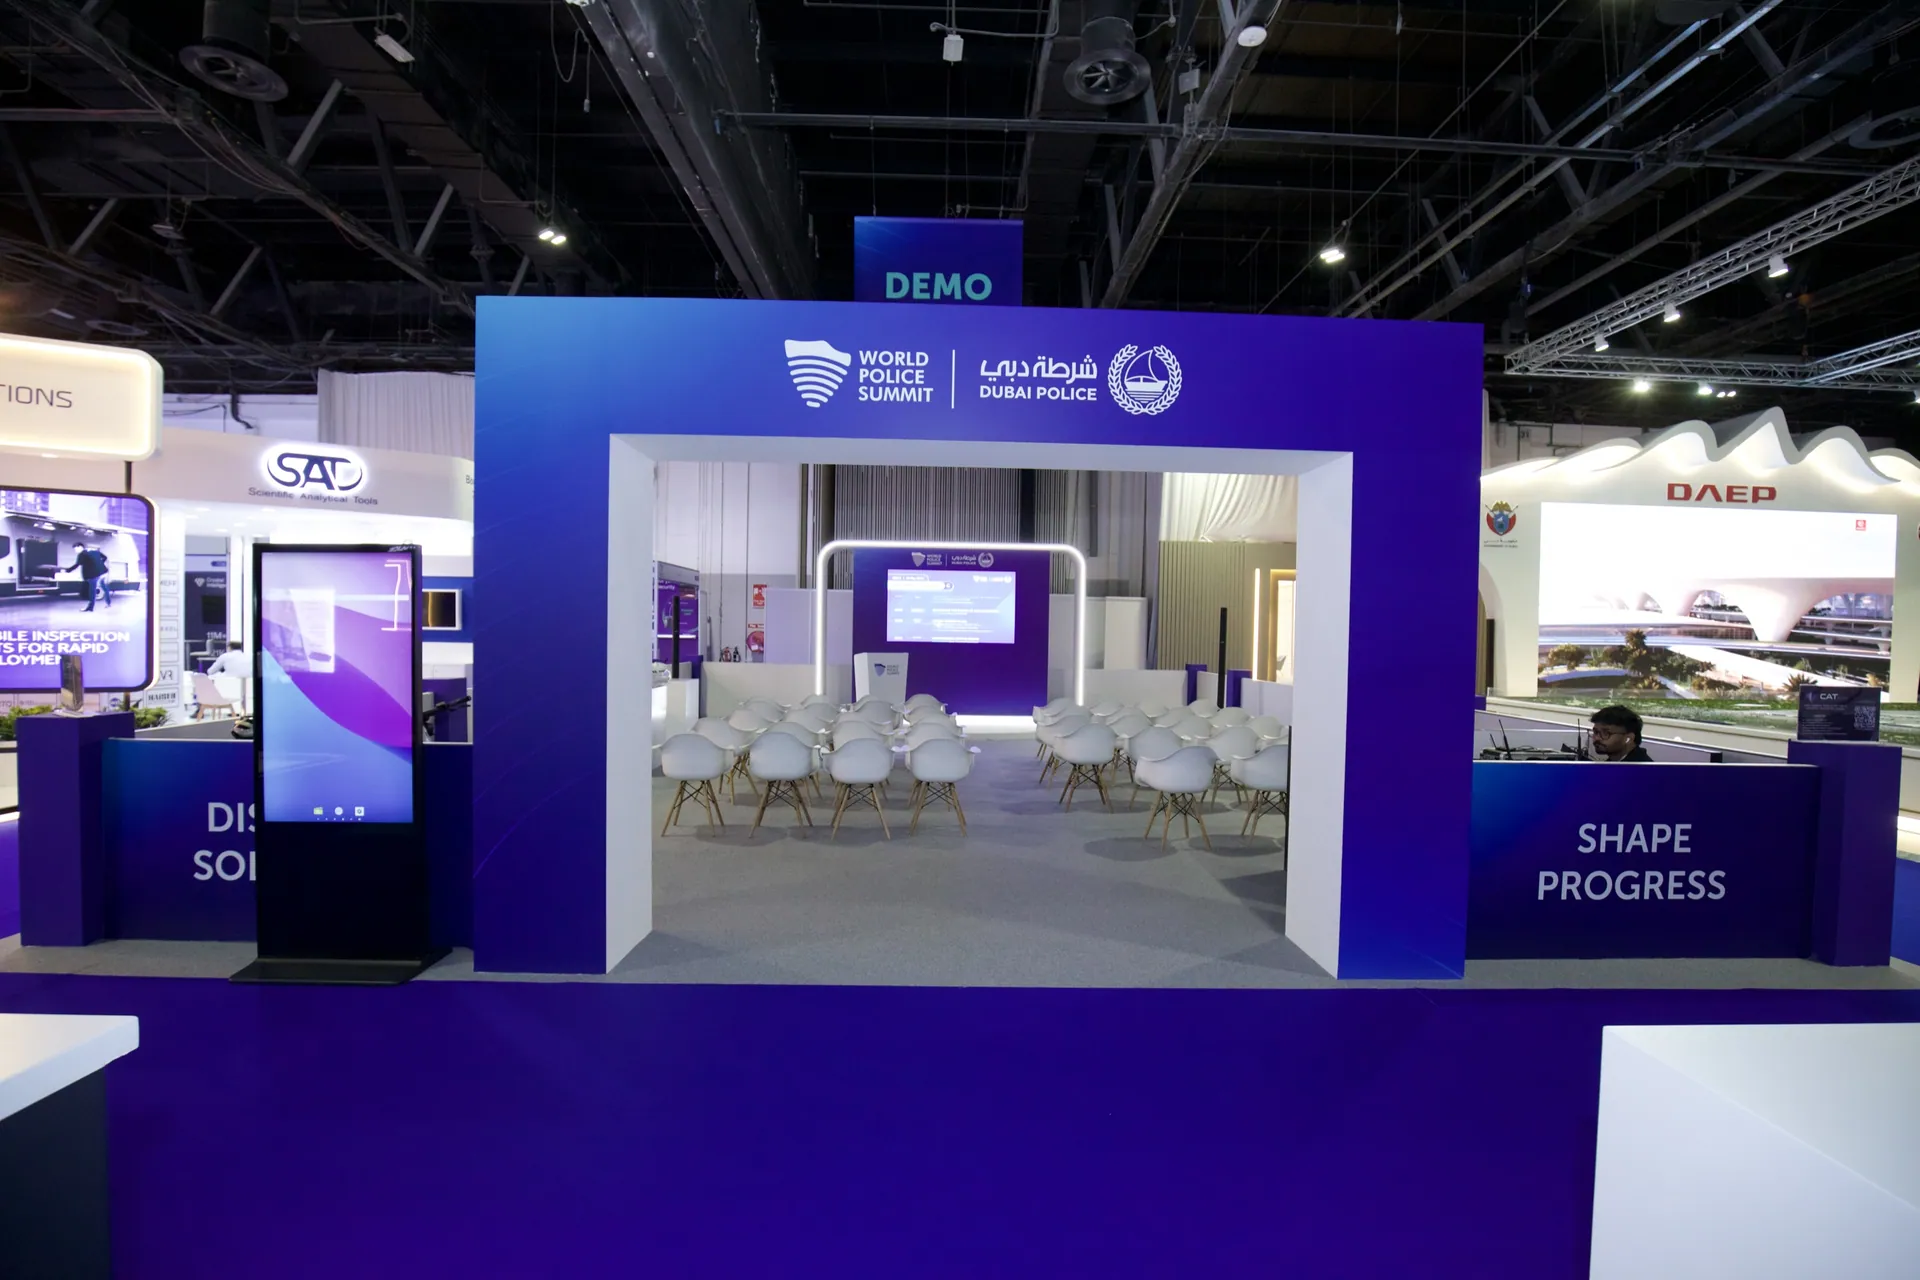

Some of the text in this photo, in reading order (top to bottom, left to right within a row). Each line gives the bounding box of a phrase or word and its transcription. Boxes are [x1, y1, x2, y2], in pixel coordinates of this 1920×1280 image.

[885, 271, 993, 301] DEMO
[858, 350, 929, 367] WORLD
[859, 368, 925, 385] POLICE
[980, 354, 1098, 385] شرطة دبي
[858, 385, 934, 403] SUMMIT
[979, 385, 1098, 401] DUBAI POLICE
[266, 452, 363, 491] SAT
[248, 487, 379, 505] Scientific Analytical Tools
[1667, 483, 1777, 504] DAEP
[32, 631, 130, 642] INSPECTION
[18, 642, 54, 653] FOR
[58, 642, 109, 654] RAPID
[1577, 823, 1692, 853] SHAPE
[1538, 870, 1726, 900] PROGRESS
